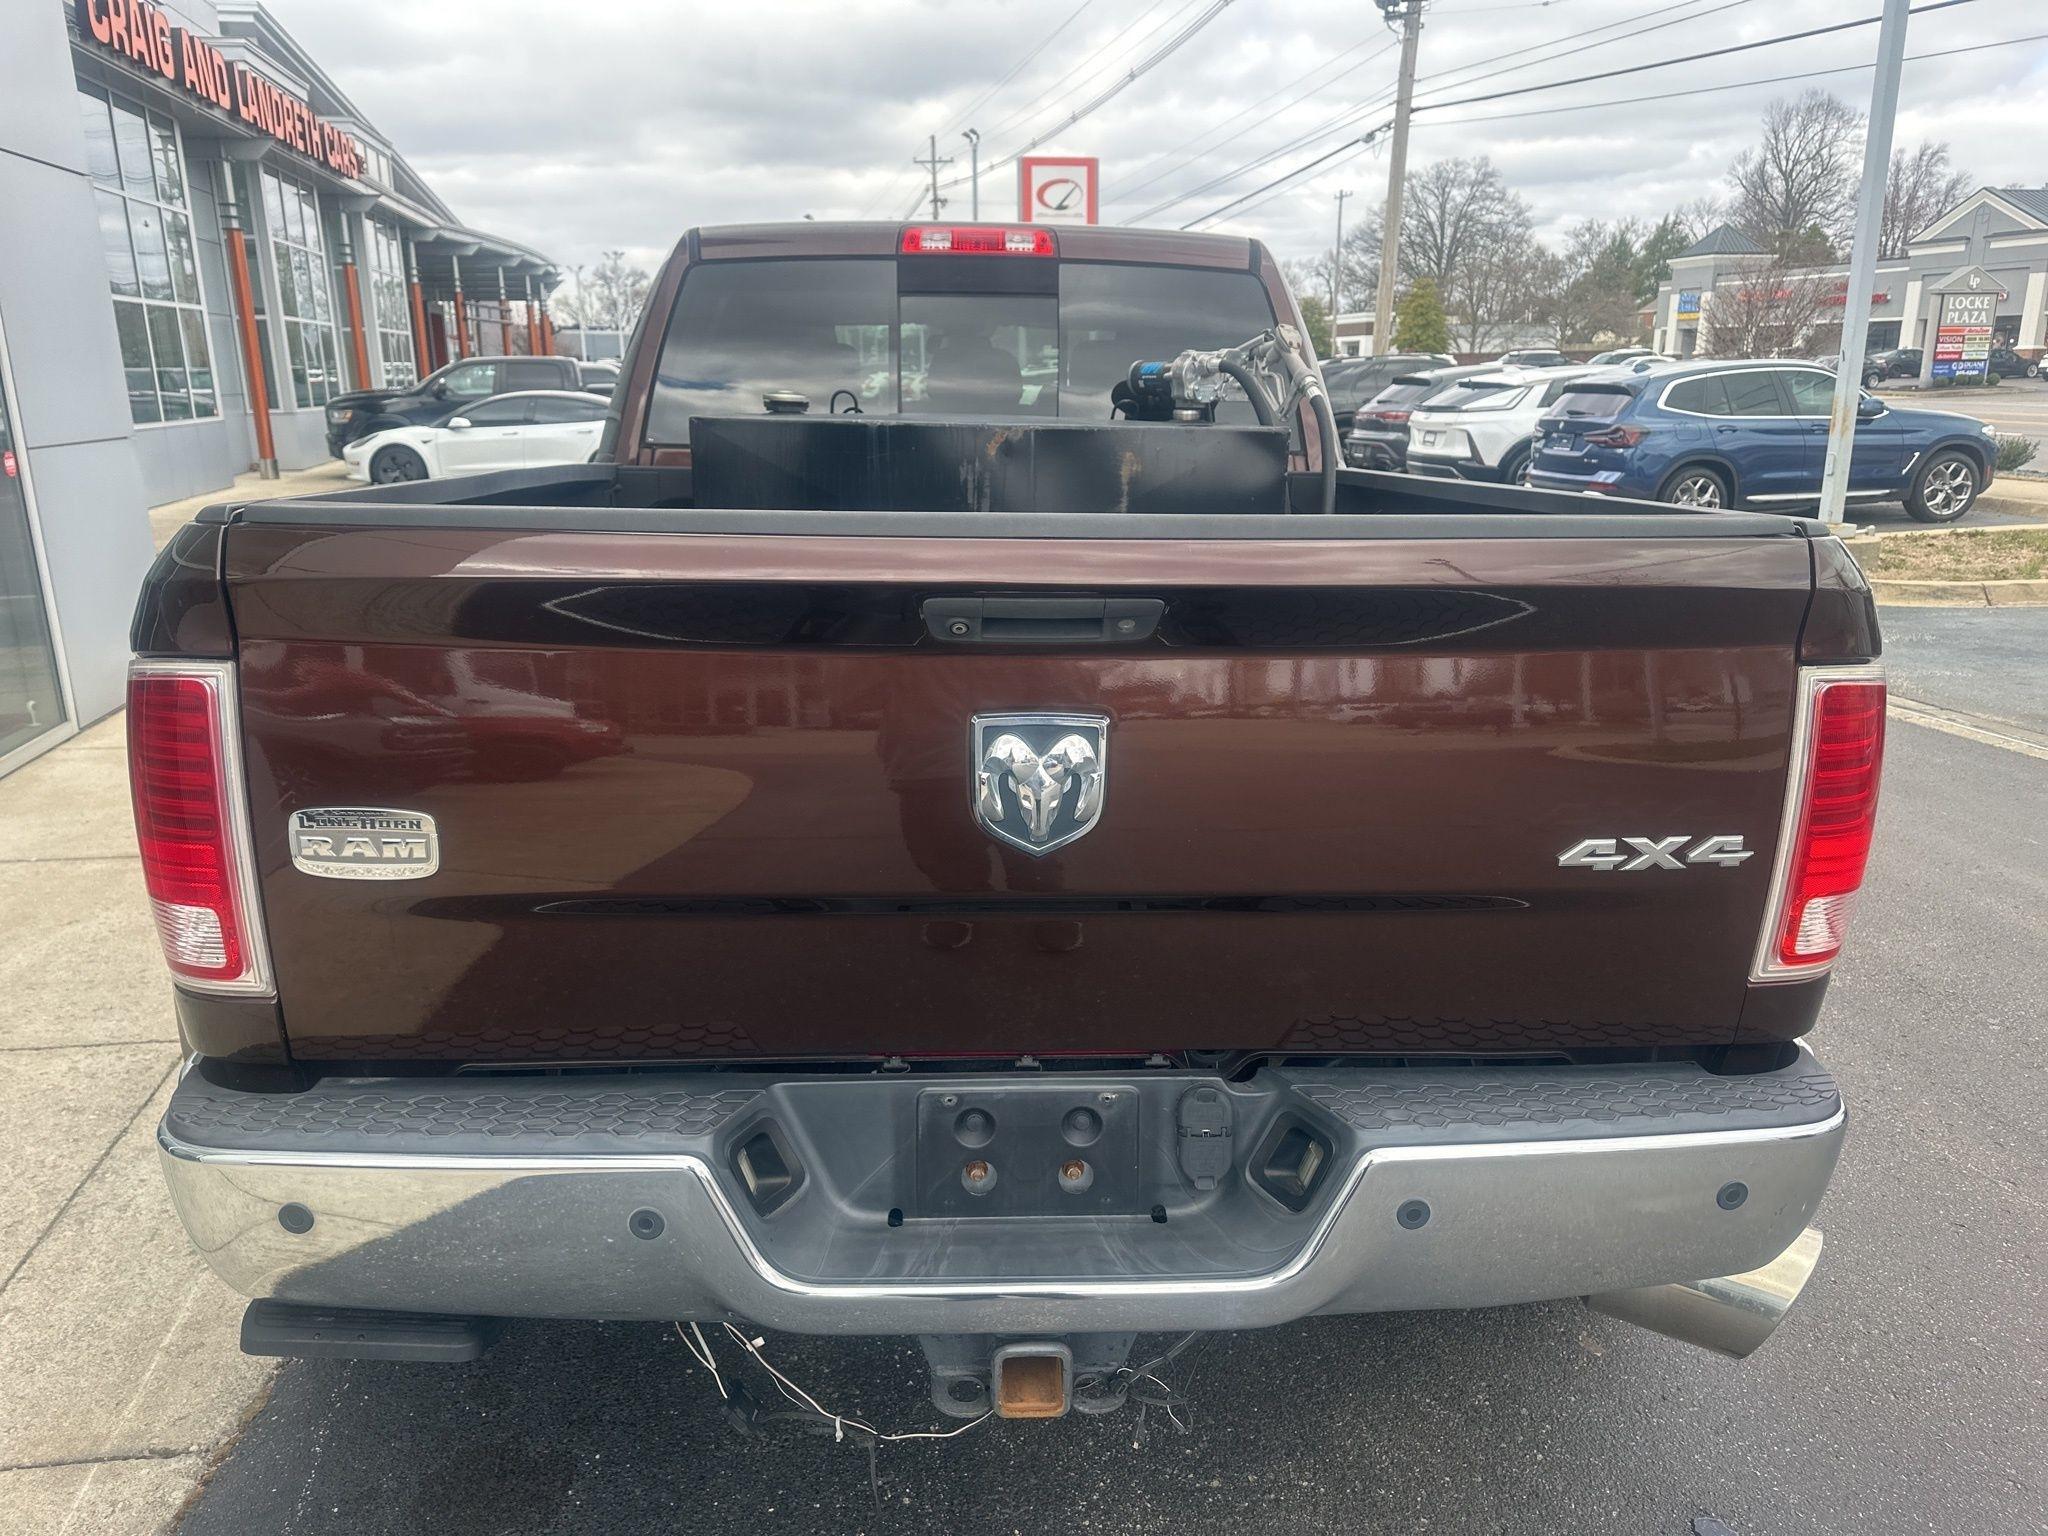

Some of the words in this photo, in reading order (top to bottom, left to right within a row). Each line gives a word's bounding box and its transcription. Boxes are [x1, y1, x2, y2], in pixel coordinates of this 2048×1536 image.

[87, 0, 175, 80] CRAIG
[181, 26, 231, 110] AND
[233, 60, 324, 162] LANDRETH
[324, 119, 359, 180] CARS
[1949, 296, 1990, 310] LOCKE
[1946, 310, 1987, 324] PLAZA
[1939, 335, 1963, 343] VISION
[300, 836, 428, 858] RAM
[1558, 834, 1755, 871] 4X4
